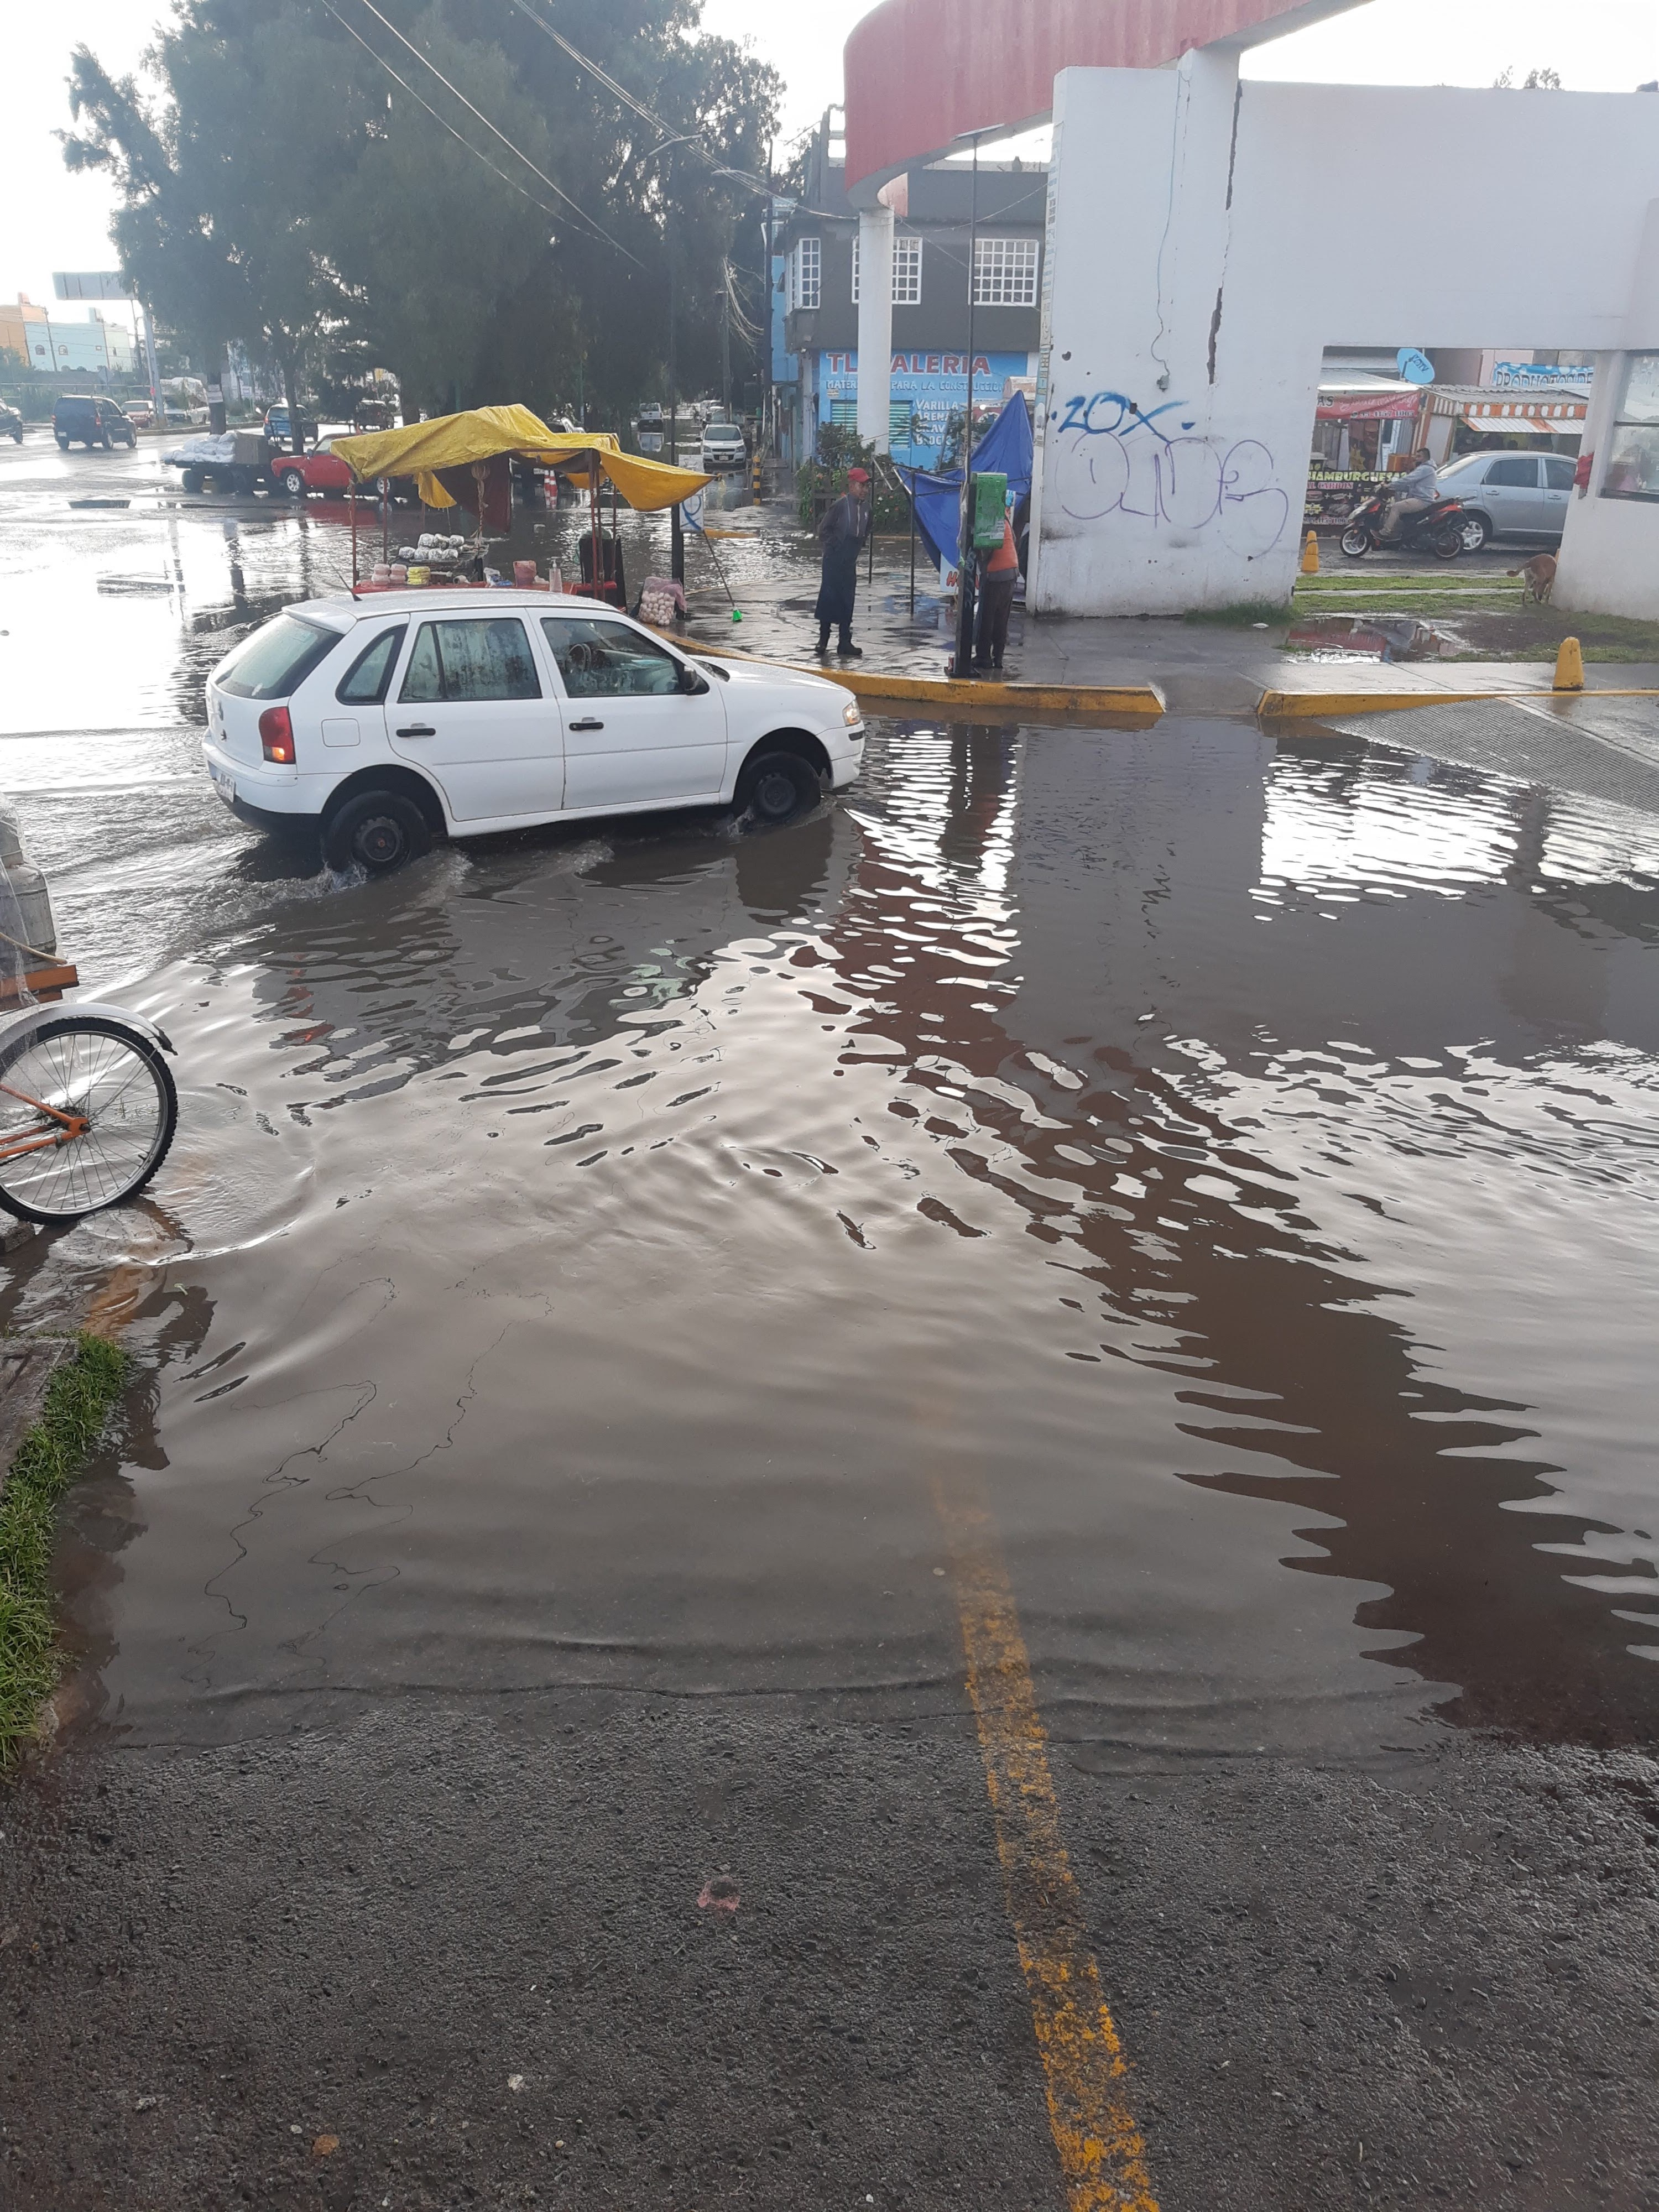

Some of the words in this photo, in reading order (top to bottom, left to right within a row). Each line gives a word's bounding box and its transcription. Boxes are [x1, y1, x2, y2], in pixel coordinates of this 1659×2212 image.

[826, 352, 992, 377] TLALERIA
[891, 380, 917, 390] PARA
[921, 382, 936, 391] LA
[916, 399, 959, 411] VARILLA
